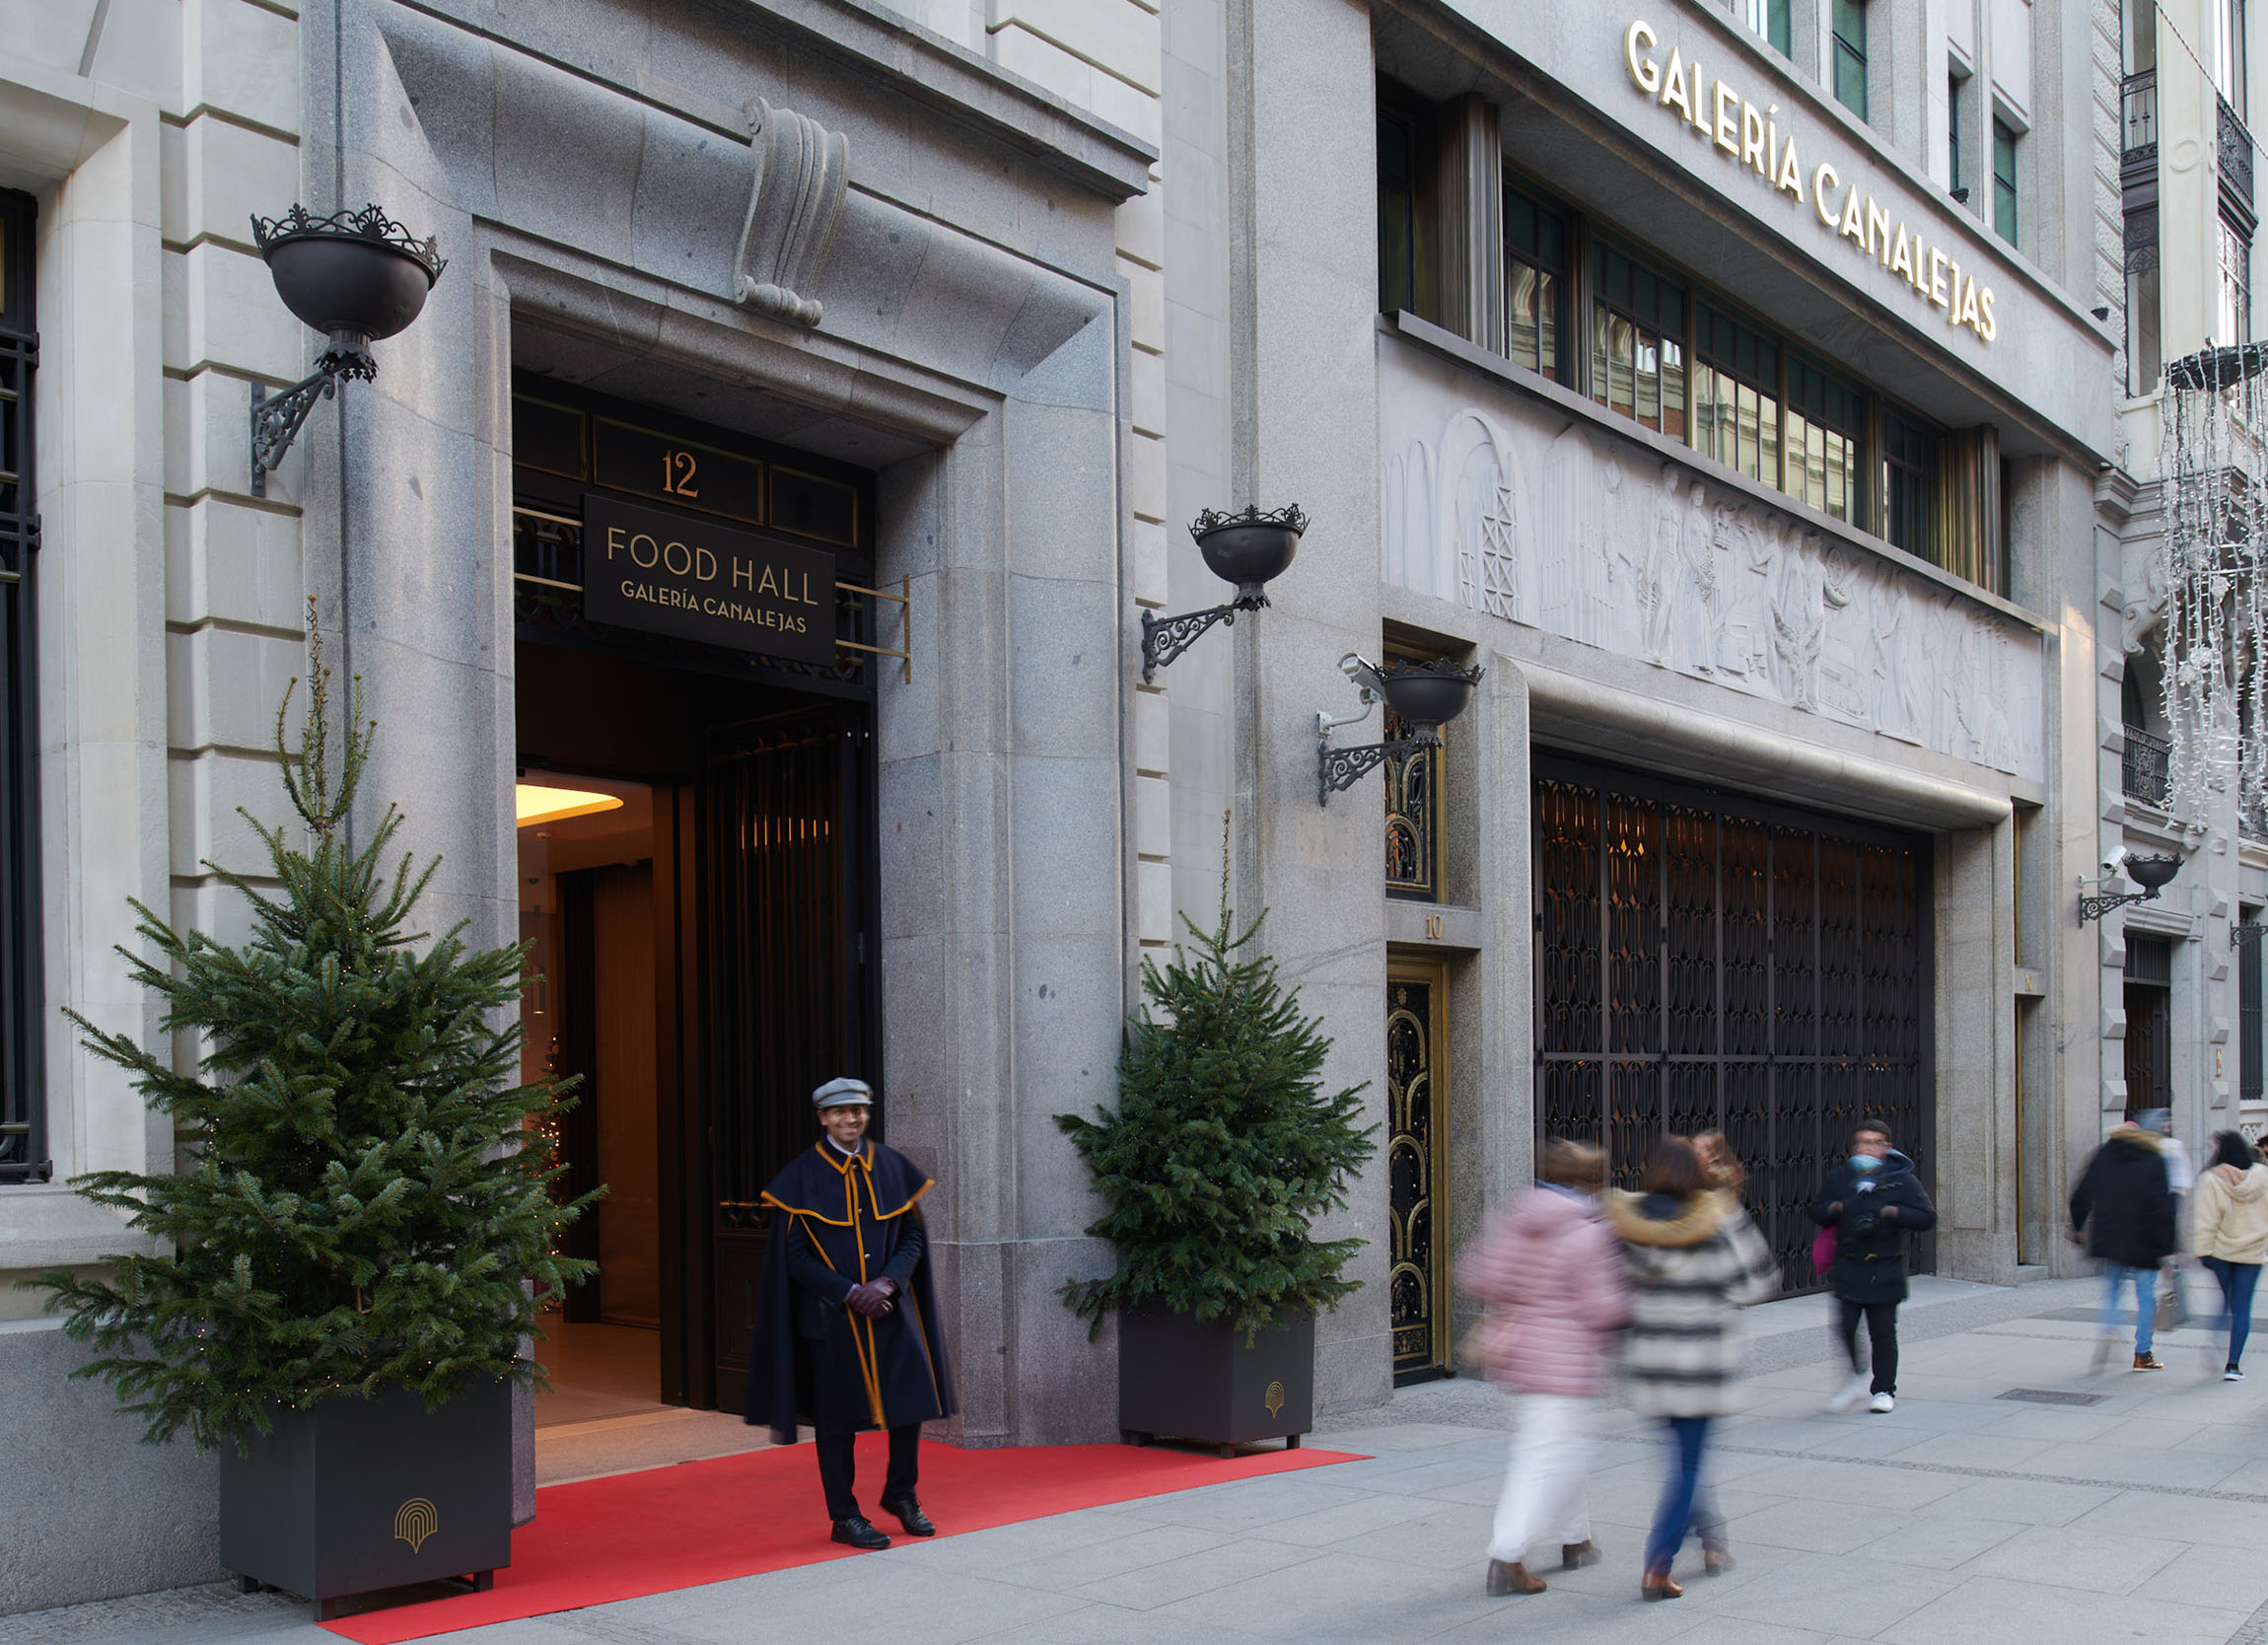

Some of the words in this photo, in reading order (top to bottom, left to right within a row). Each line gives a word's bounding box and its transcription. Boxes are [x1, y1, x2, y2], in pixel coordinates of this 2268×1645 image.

[1625, 20, 1804, 203] GALERÍA
[1812, 163, 1996, 342] CANALEJAS
[662, 450, 699, 497] 12
[607, 527, 718, 581] FOOD
[733, 556, 818, 606] HALL
[620, 580, 699, 611] GALERÍA
[703, 598, 807, 633] CANALEJAS
[1427, 914, 1443, 940] 10
